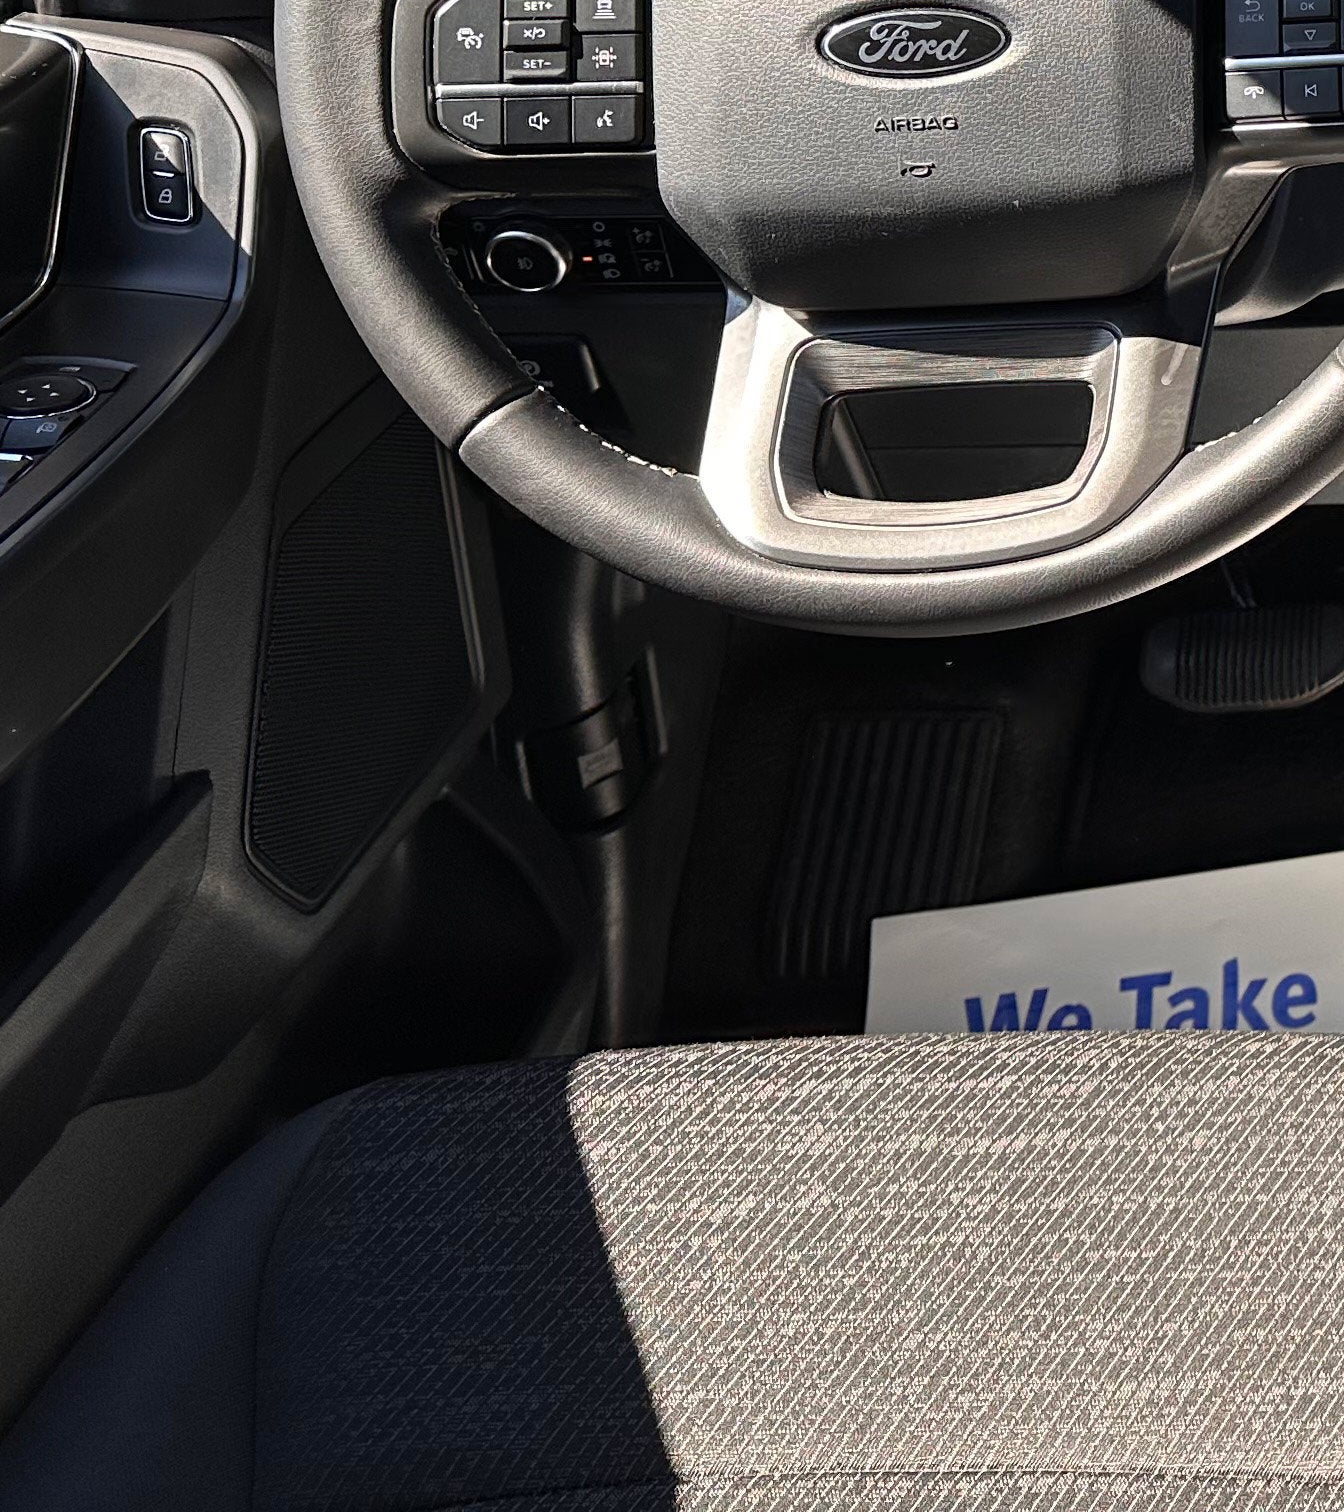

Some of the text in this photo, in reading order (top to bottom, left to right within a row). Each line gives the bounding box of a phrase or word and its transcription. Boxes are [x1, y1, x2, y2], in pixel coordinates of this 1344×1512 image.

[523, 0, 553, 12] SET+
[1299, 1, 1315, 12] OK
[1238, 12, 1265, 23] BACK
[858, 20, 970, 64] Ford
[874, 116, 959, 133] AIRBAG
[1120, 957, 1318, 1031] Take
